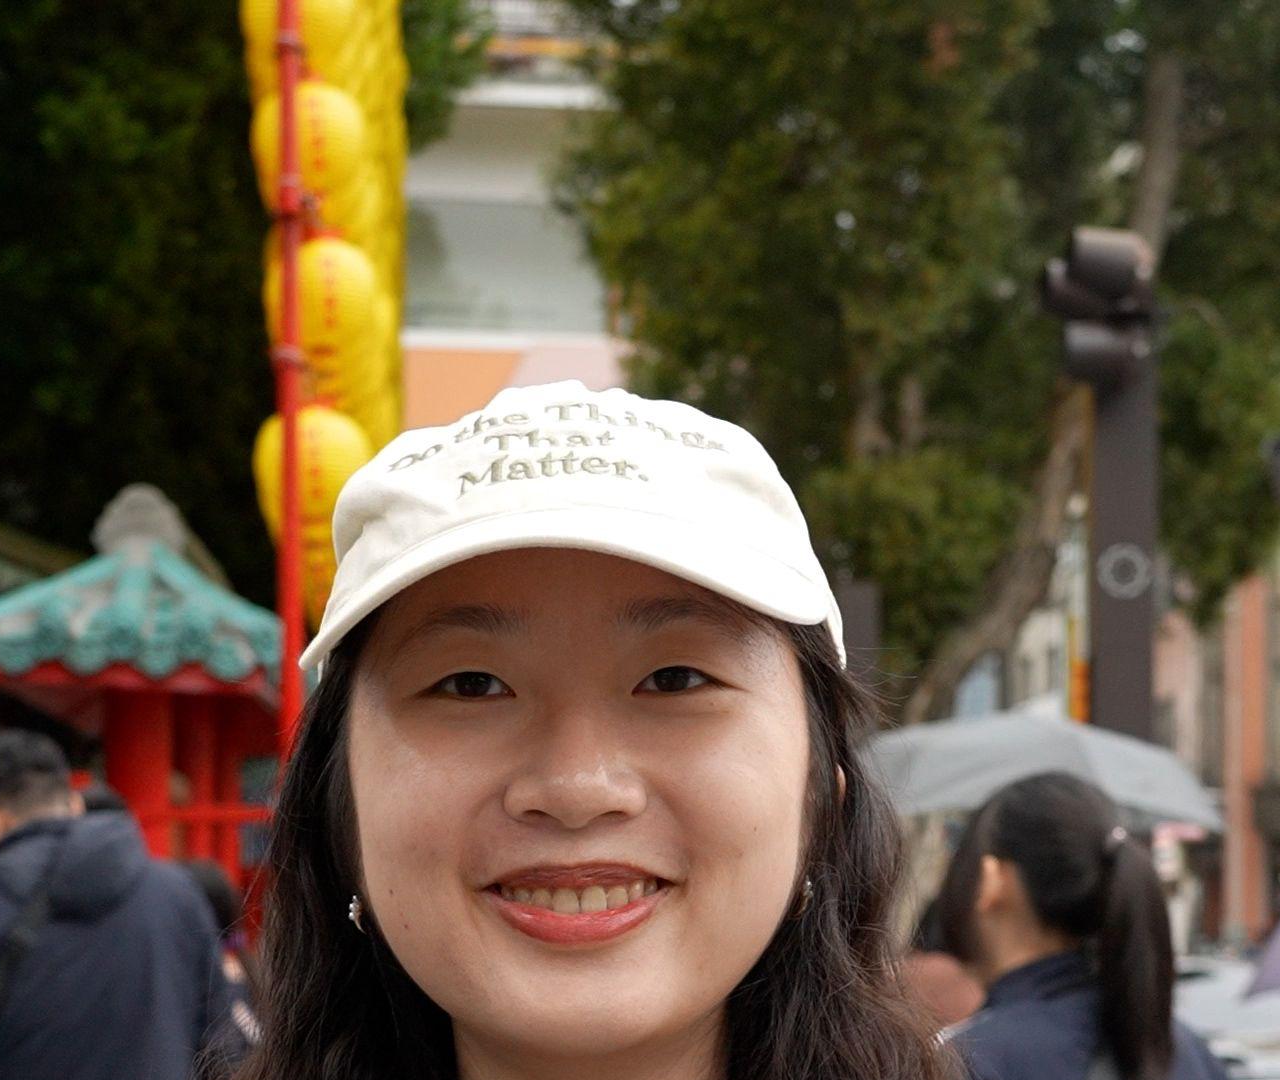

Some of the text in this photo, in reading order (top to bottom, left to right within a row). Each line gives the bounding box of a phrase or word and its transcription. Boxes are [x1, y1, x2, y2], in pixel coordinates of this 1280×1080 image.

[387, 442, 445, 473] Do
[454, 411, 530, 444] the
[483, 428, 616, 451] That
[456, 451, 651, 500] Matter.
